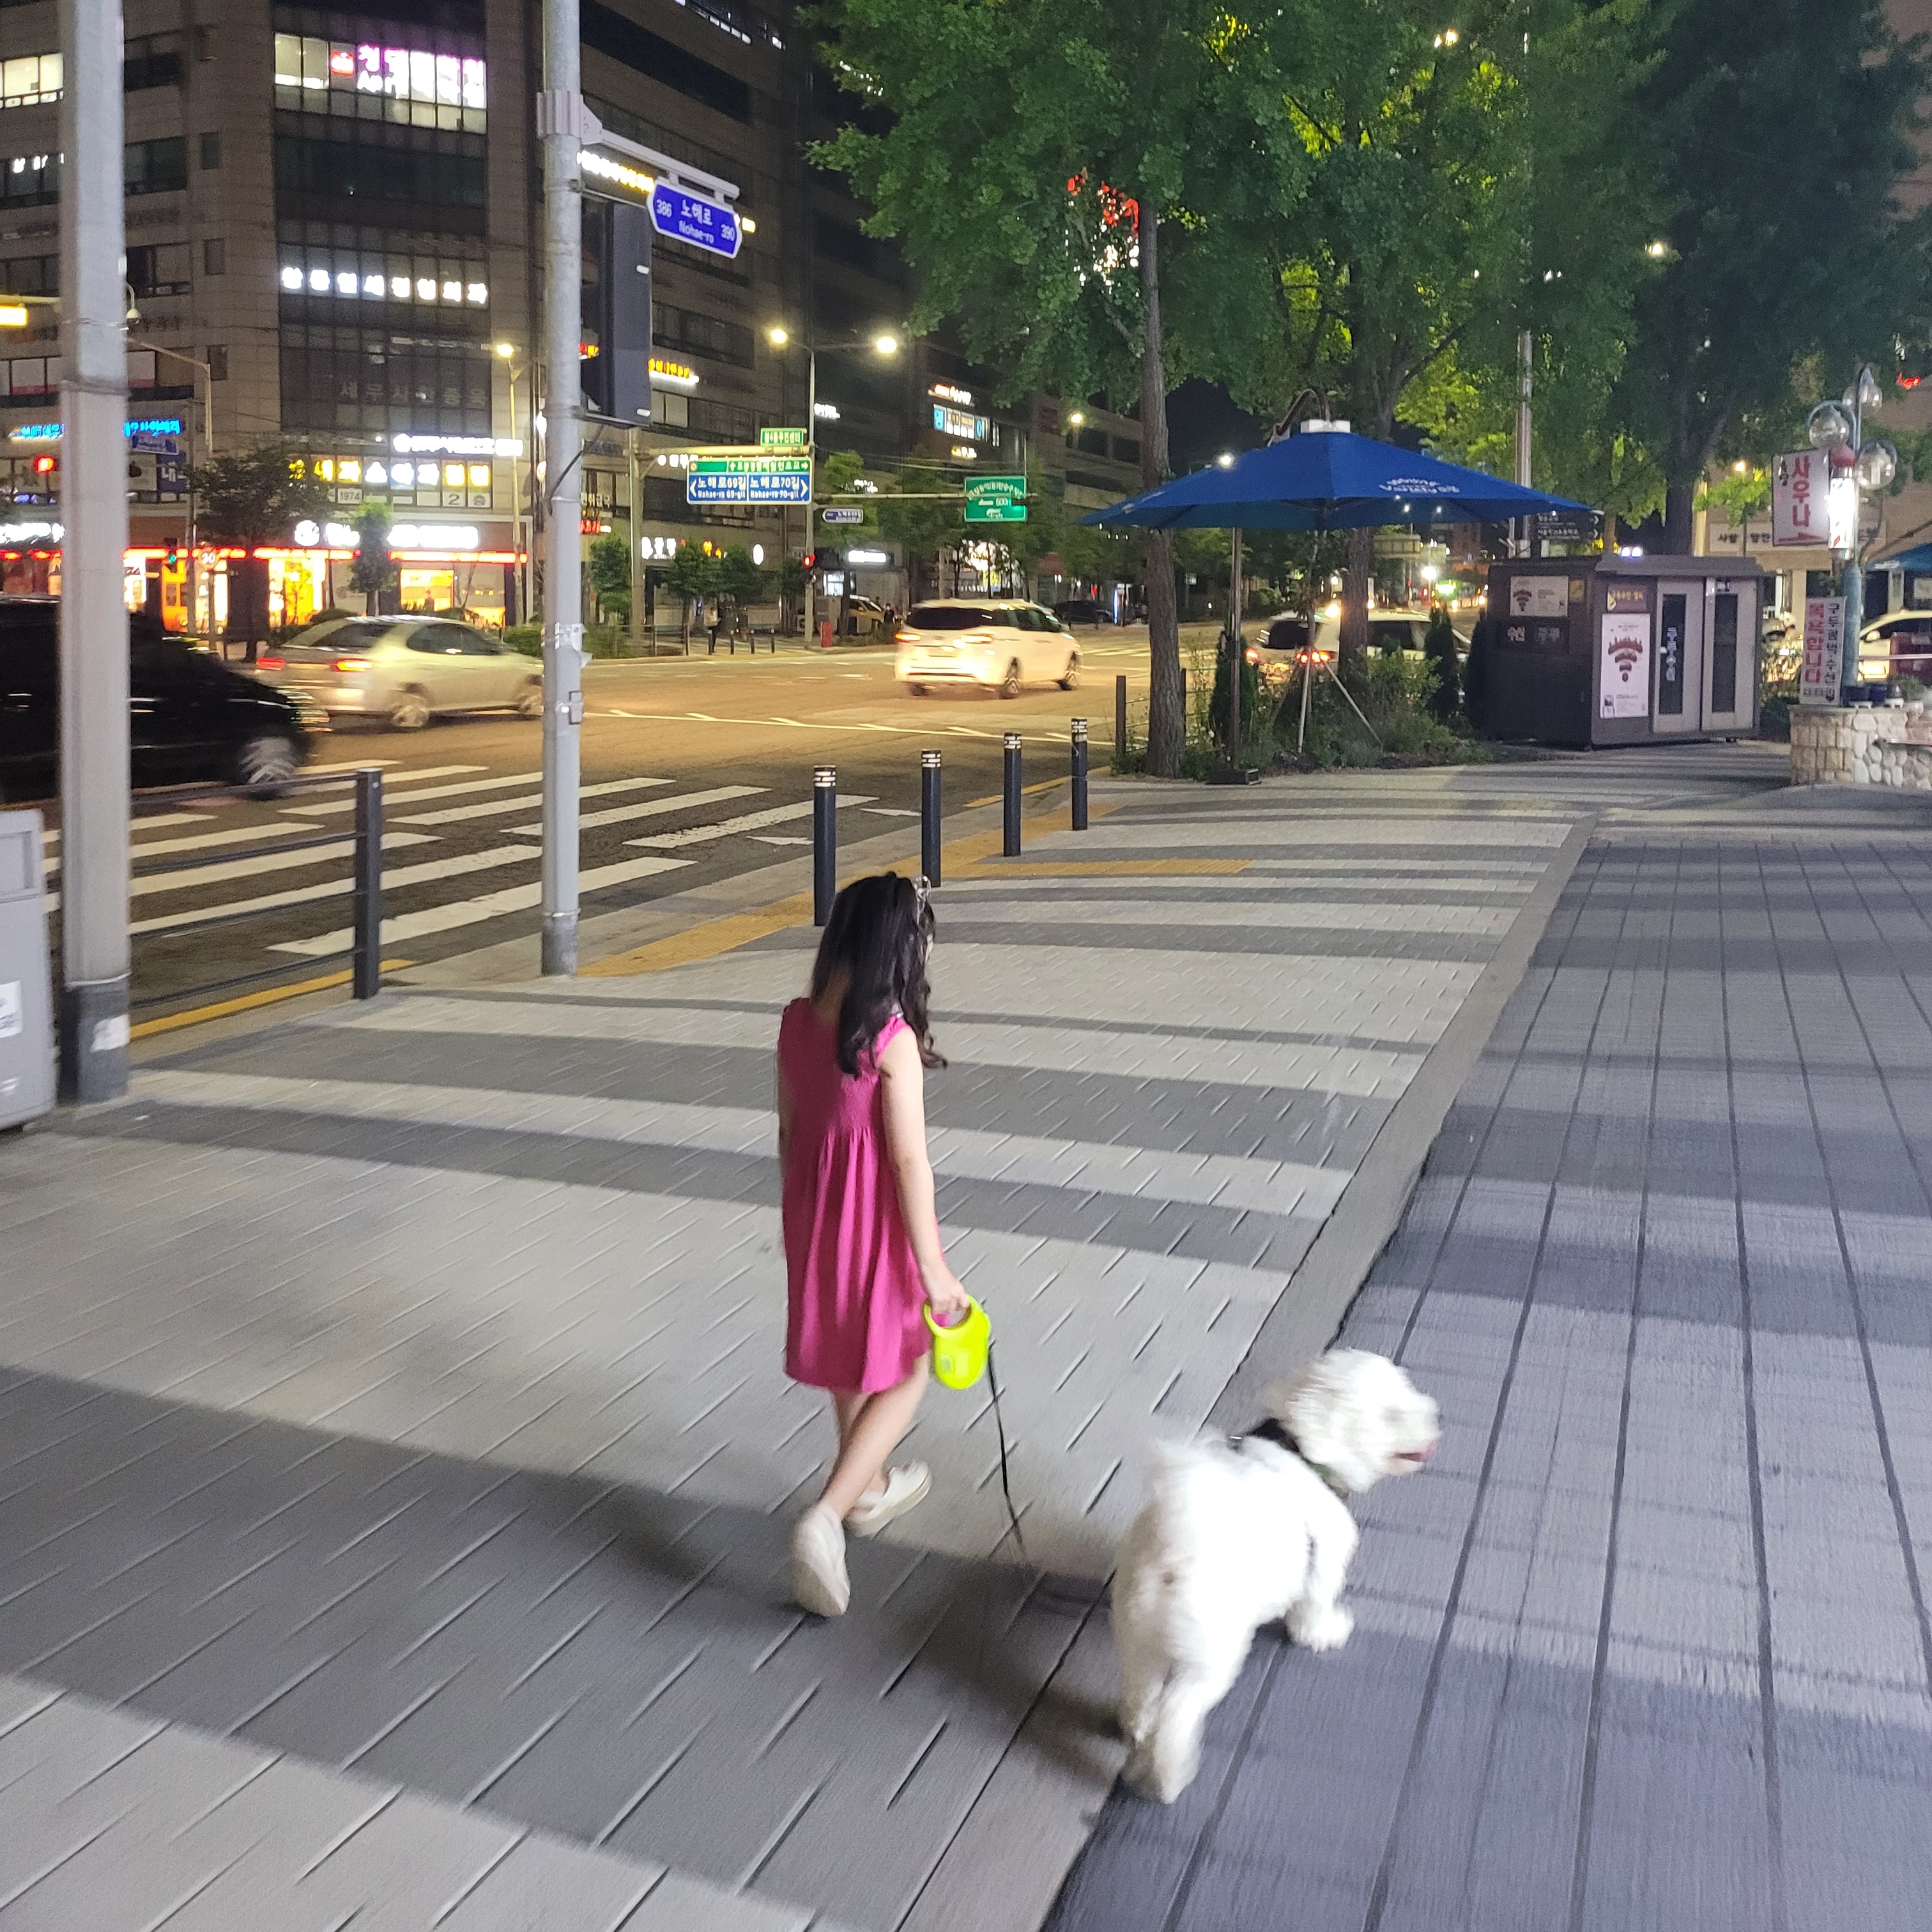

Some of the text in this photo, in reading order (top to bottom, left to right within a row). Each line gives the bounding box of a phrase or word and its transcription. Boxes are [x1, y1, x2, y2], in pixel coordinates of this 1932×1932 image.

[656, 199, 735, 241] 386 노해로 390
[678, 220, 715, 245] Nohae-ro
[698, 477, 746, 491] 노해로69길
[749, 477, 800, 491] 노해로70길
[340, 491, 360, 502] 1974
[698, 489, 725, 498] Nohae-ro
[750, 489, 778, 498] Nohae-ro
[1792, 456, 1811, 527] 사우나
